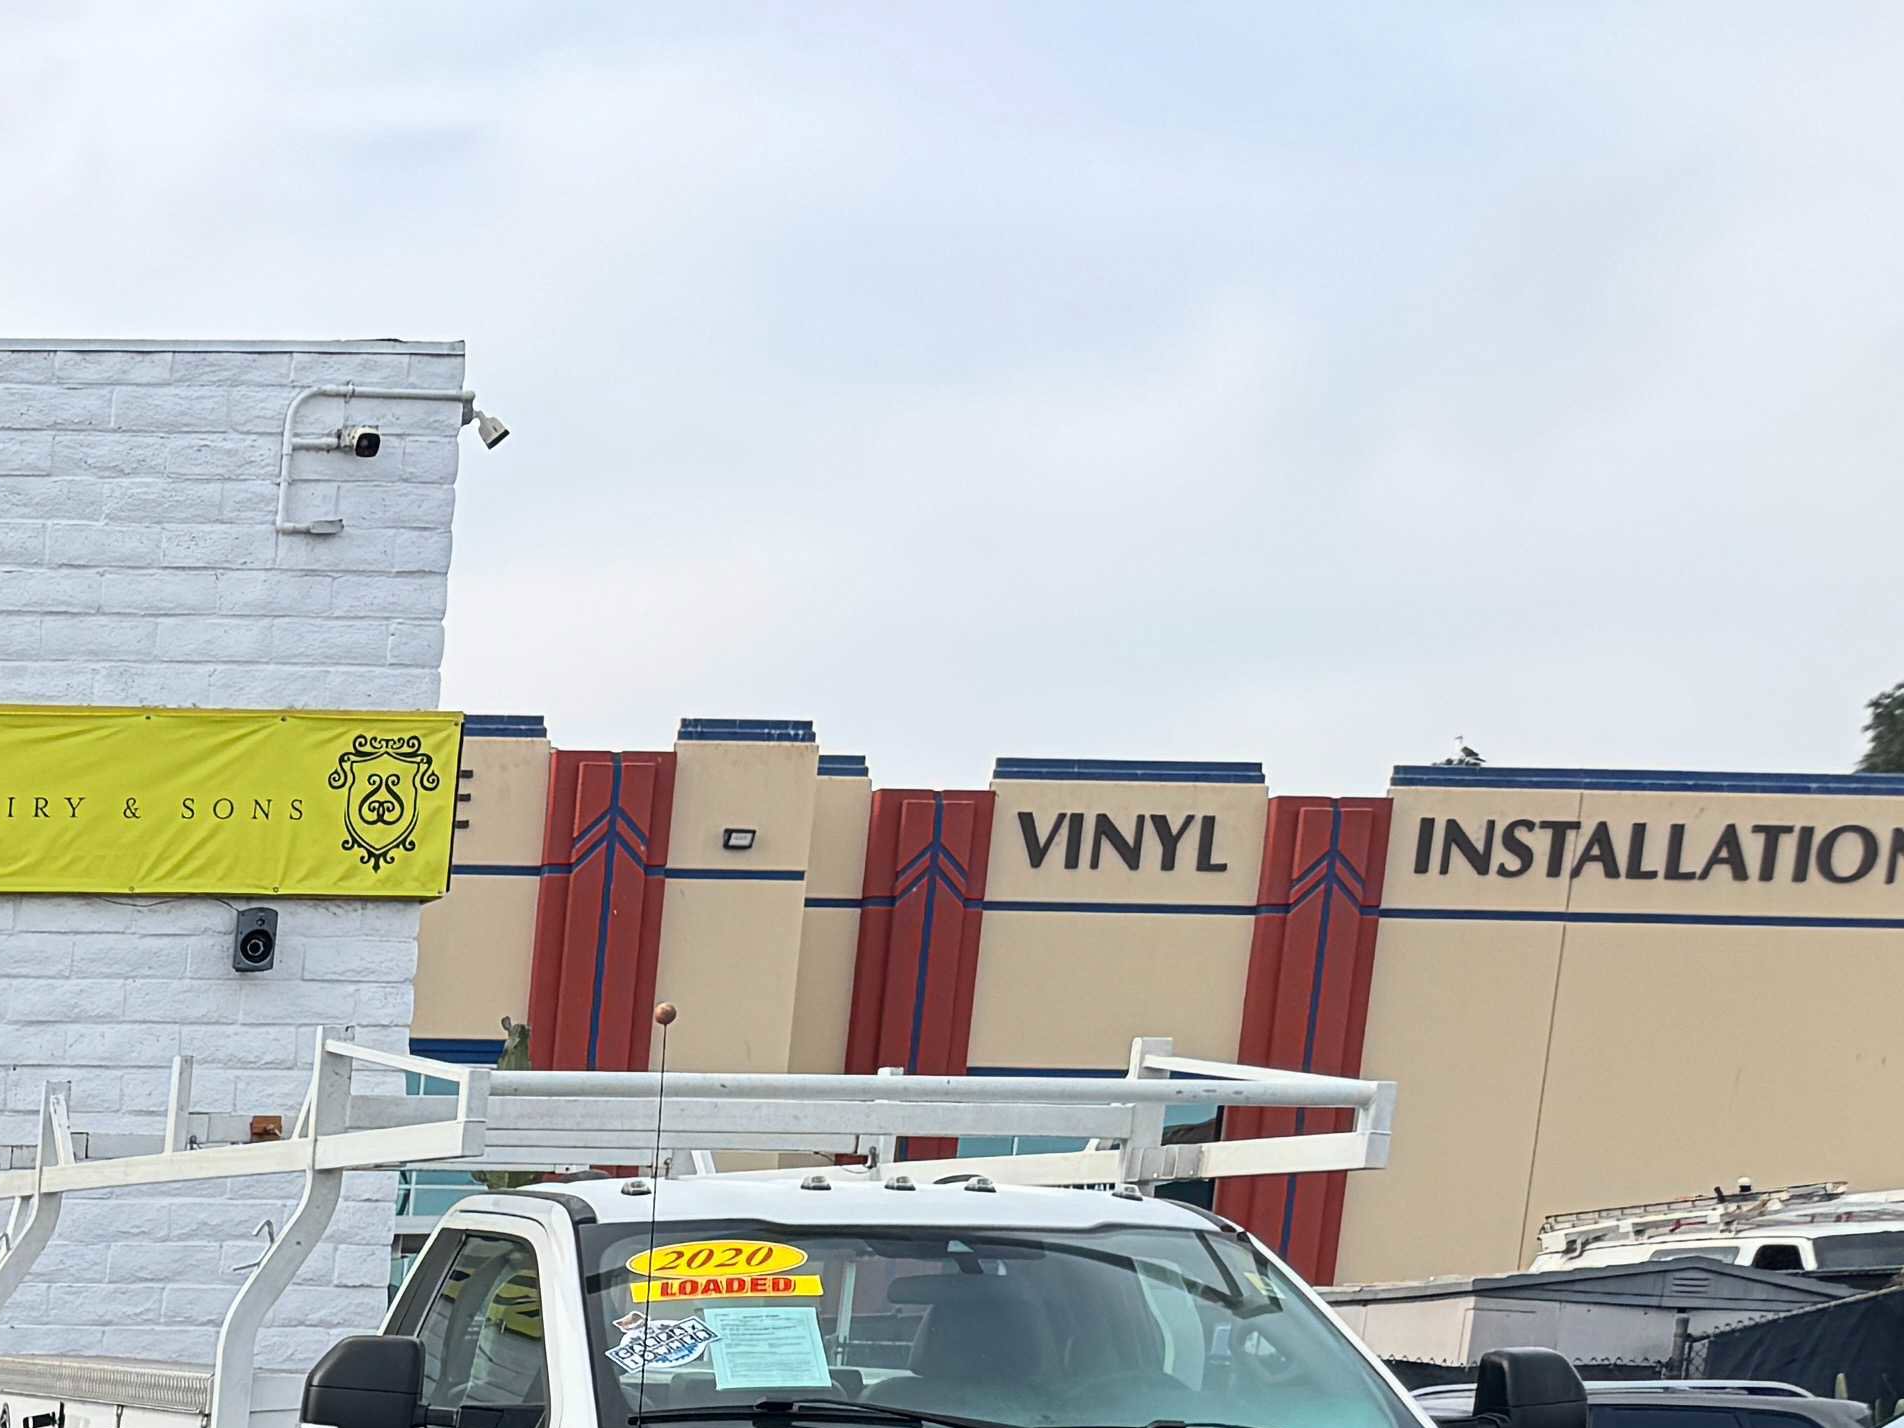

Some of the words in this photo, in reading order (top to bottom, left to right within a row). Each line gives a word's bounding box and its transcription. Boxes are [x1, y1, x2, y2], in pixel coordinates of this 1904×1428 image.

[123, 797, 142, 819] &
[181, 797, 304, 820] SONS
[1017, 811, 1229, 873] VINYL
[655, 1245, 774, 1272] 2020
[659, 1276, 797, 1298] LOADED
